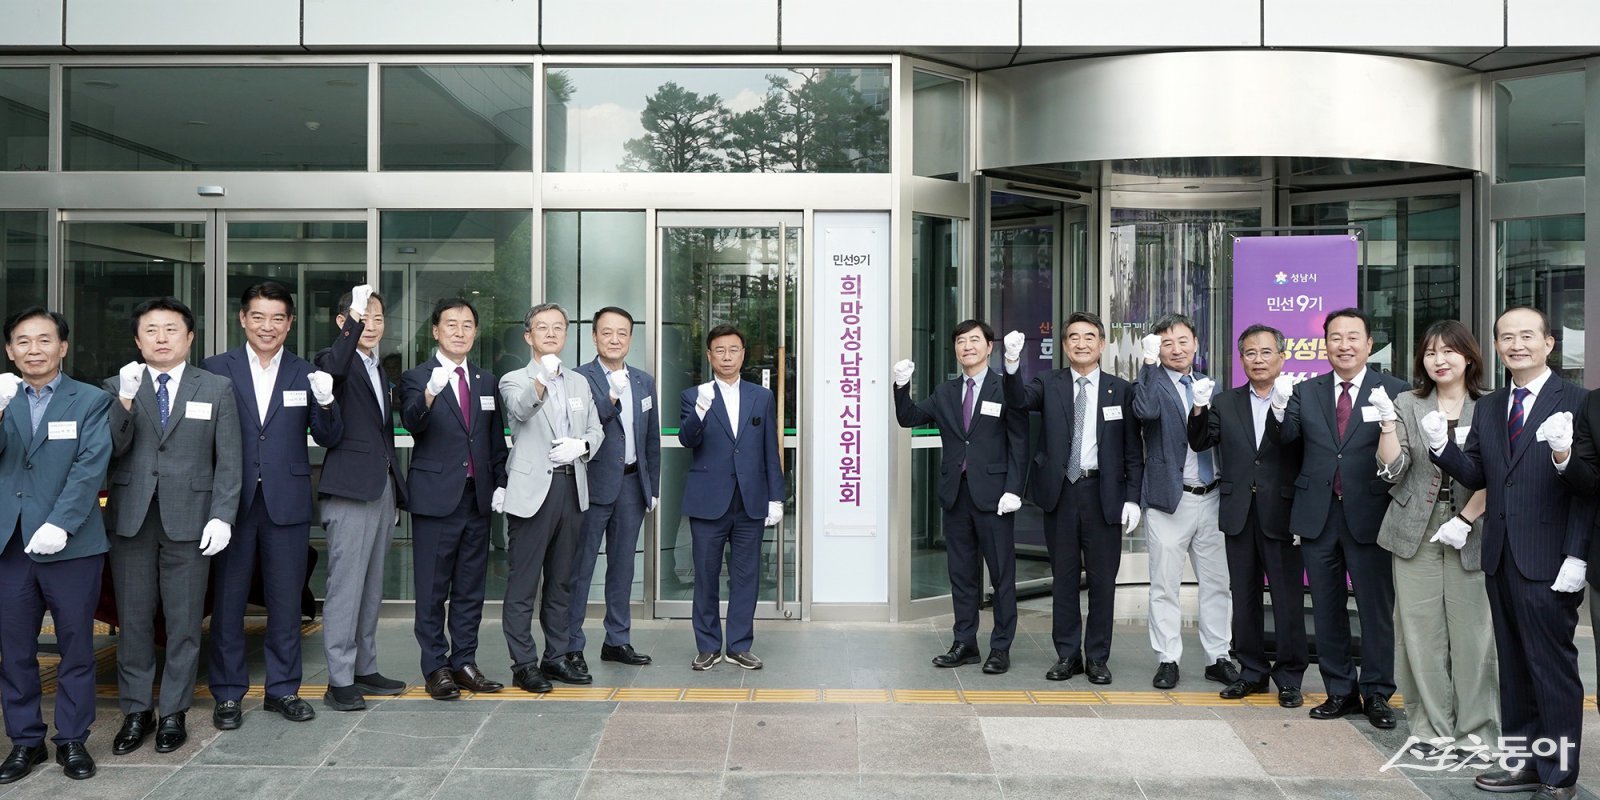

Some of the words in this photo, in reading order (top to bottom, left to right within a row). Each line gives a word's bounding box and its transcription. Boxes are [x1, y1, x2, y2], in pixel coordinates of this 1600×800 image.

[833, 254, 870, 266] 민선9기
[1290, 273, 1317, 283] 성남시
[839, 274, 863, 507] 희망성남혁신위원회
